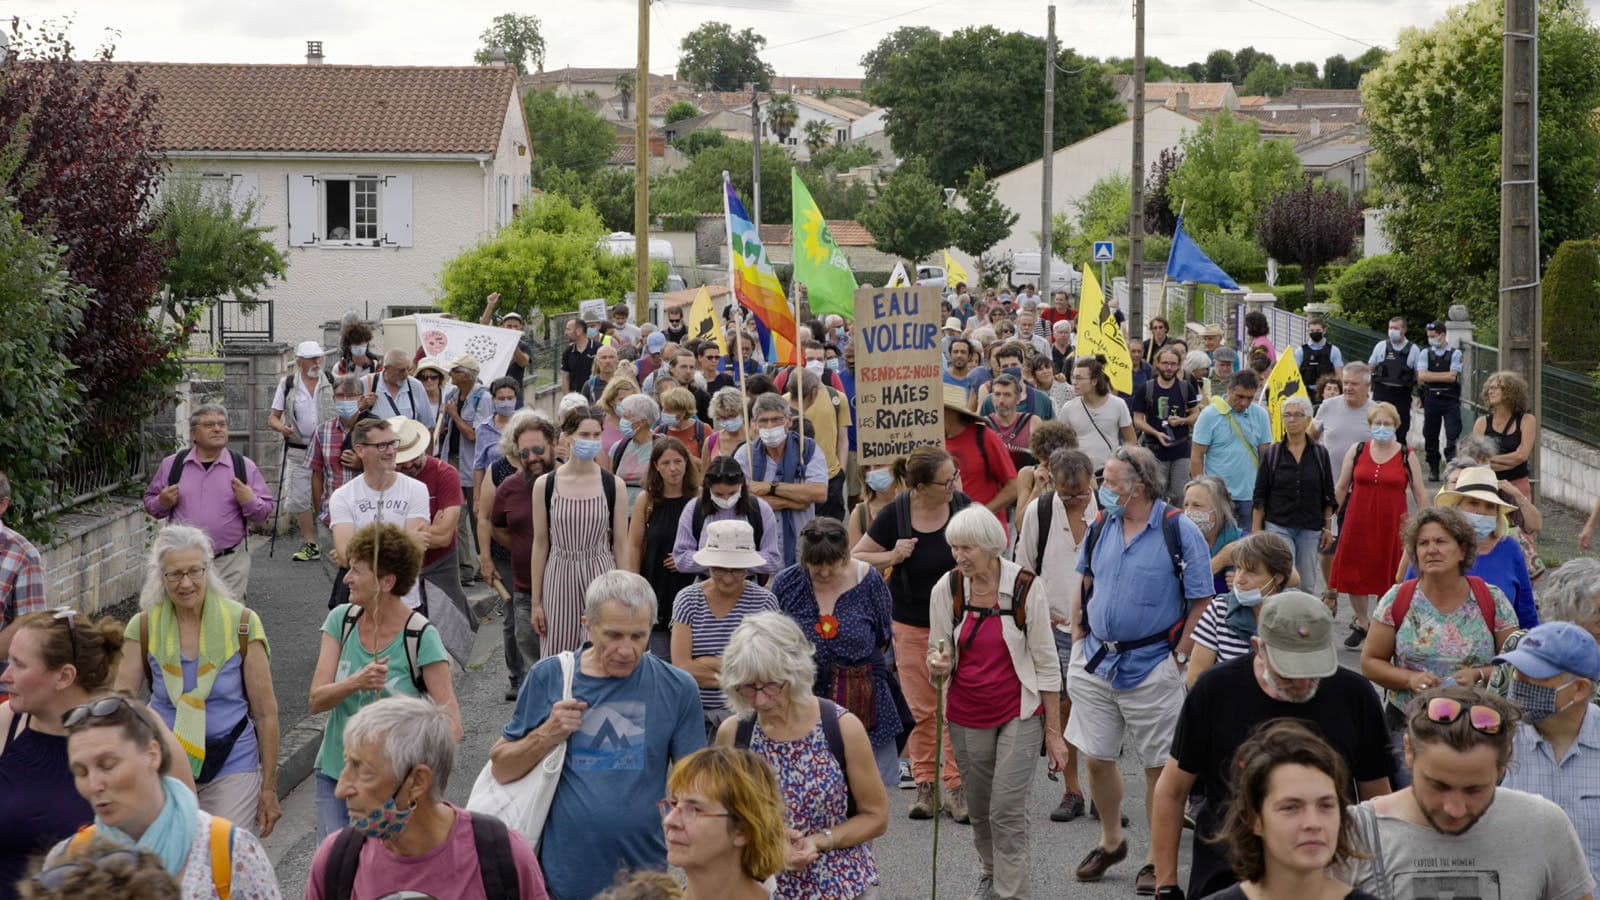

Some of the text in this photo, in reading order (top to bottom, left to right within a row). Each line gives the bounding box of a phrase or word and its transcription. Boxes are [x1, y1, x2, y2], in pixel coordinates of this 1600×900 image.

[873, 291, 919, 319] EAU
[862, 322, 938, 354] VOLEUR
[860, 365, 940, 382] RENDEZ-NOUS
[859, 417, 875, 428] LES
